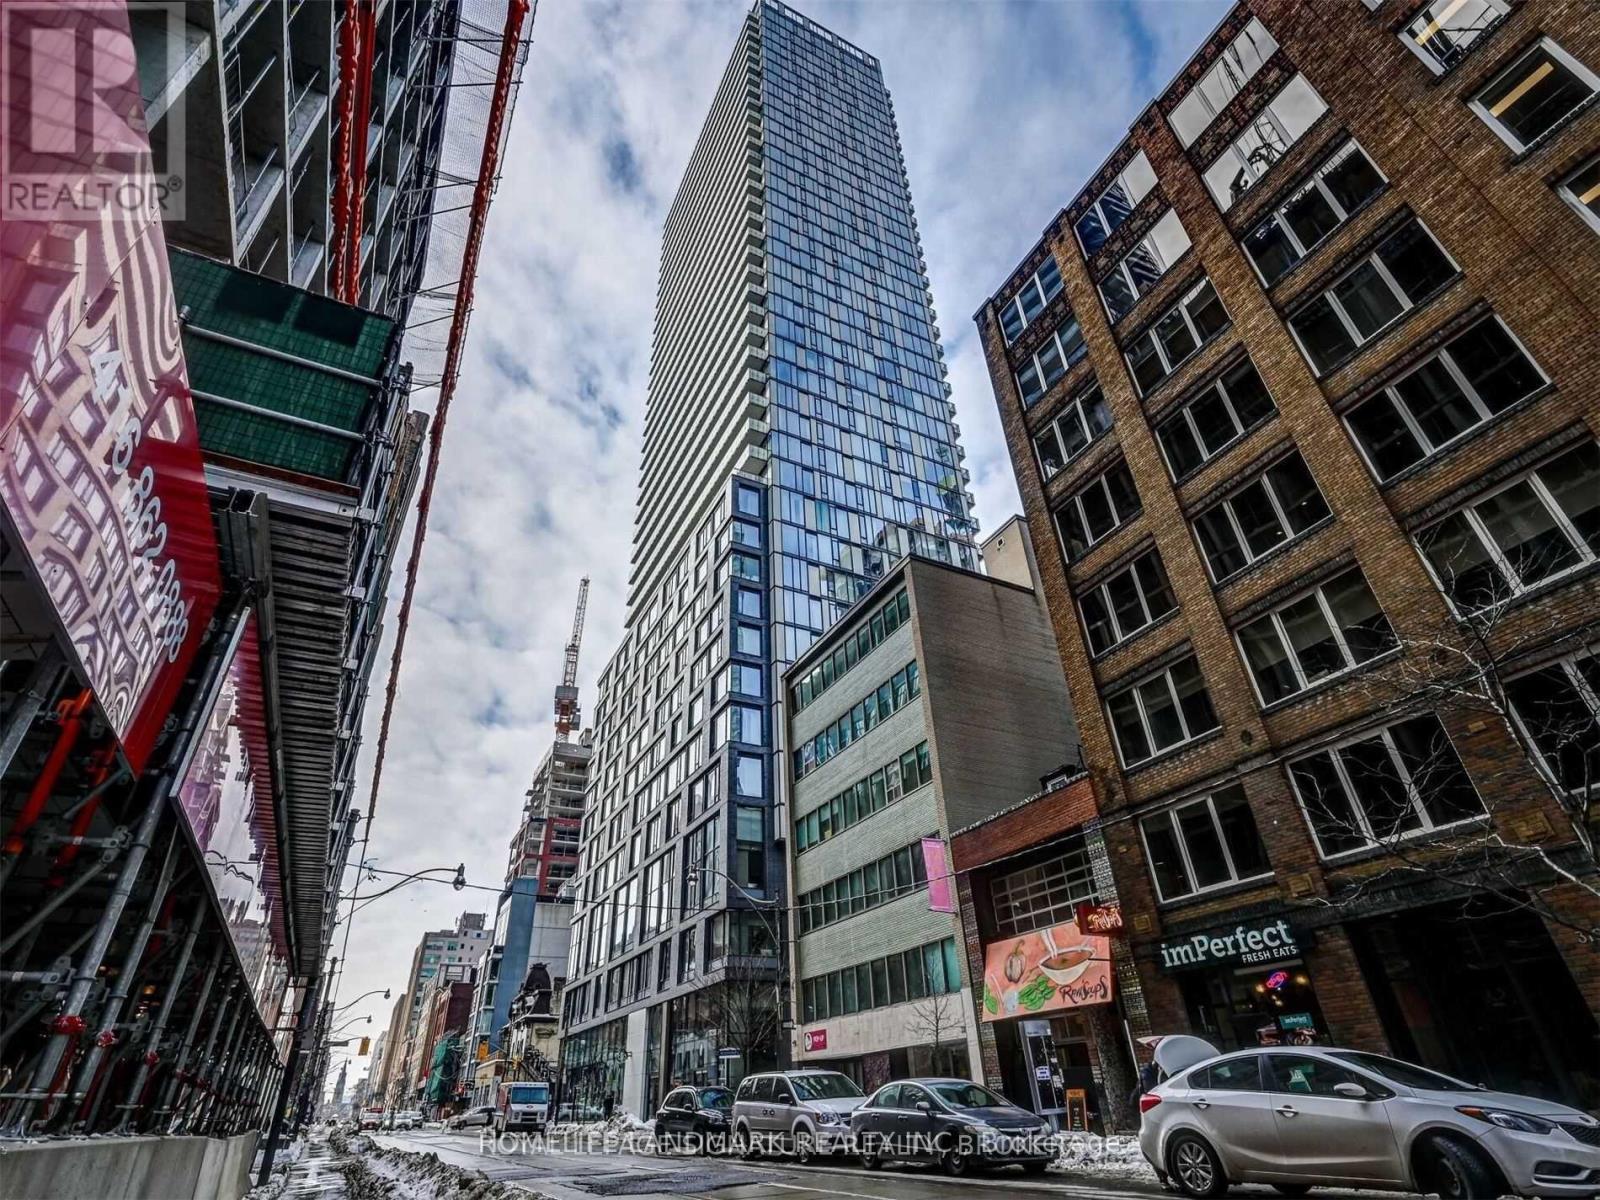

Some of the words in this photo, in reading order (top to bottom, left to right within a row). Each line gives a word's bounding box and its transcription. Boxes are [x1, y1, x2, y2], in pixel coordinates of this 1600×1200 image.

[1161, 920, 1294, 967] imPerfect
[1241, 951, 1272, 964] FRESH
[1273, 945, 1297, 958] EATS
